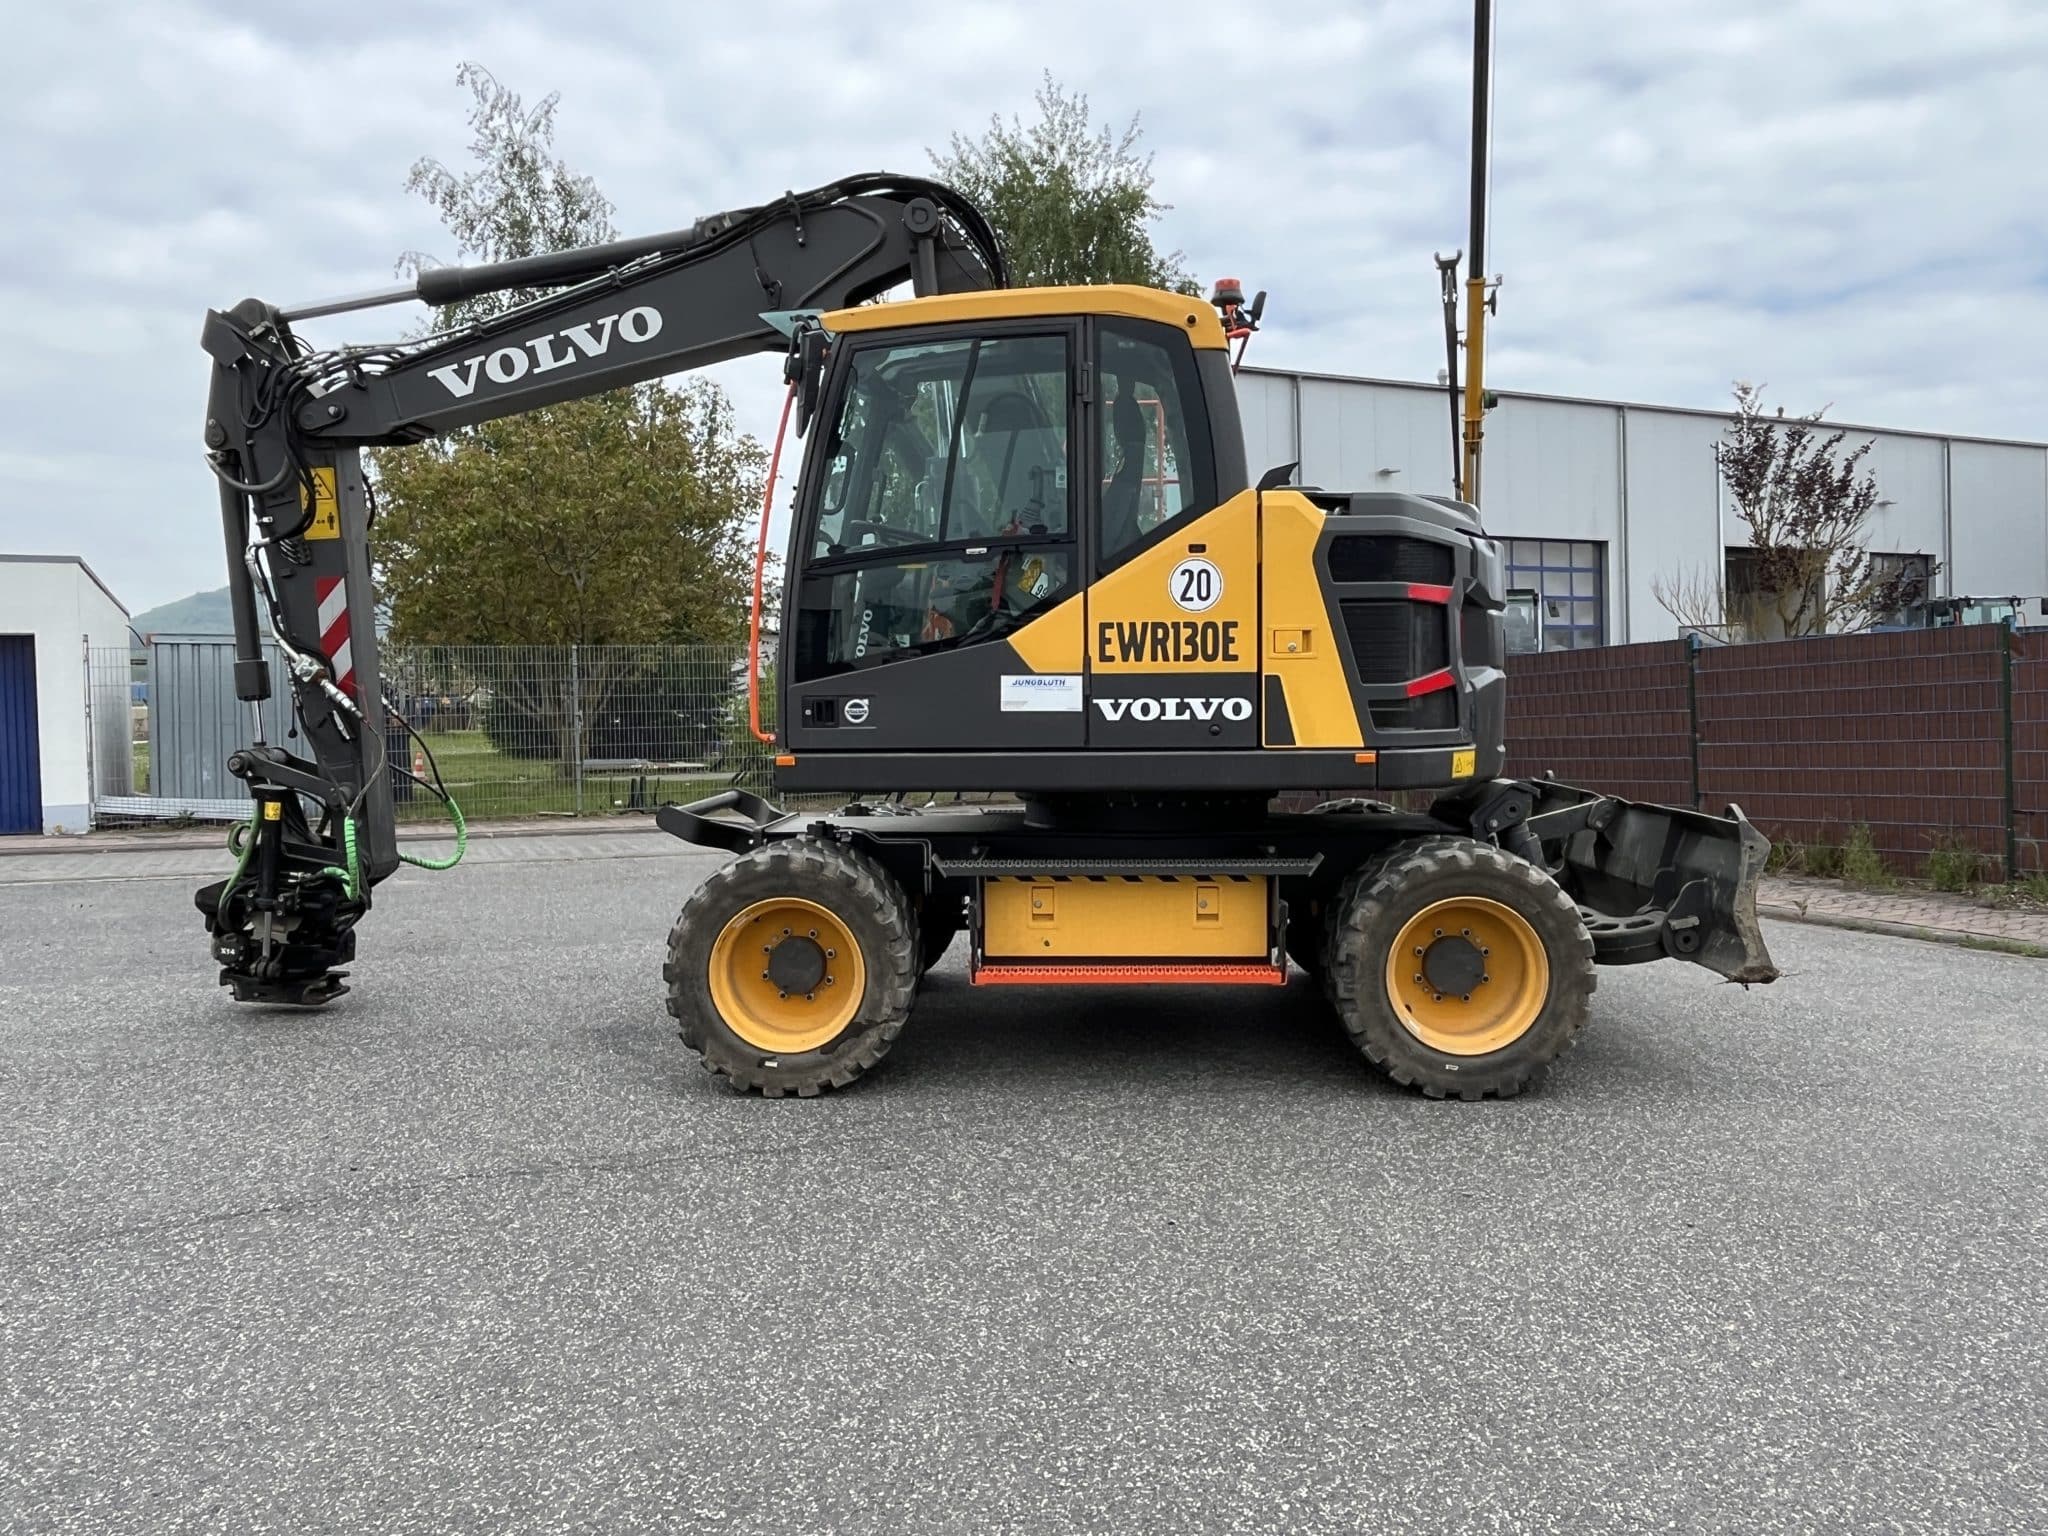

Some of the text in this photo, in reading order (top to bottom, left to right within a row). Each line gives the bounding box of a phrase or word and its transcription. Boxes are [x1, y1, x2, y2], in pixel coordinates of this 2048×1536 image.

[426, 306, 663, 398] VOLVO
[1180, 568, 1211, 602] 20
[855, 609, 873, 659] OLVO
[1098, 621, 1239, 663] EWR130E
[1092, 697, 1253, 721] VOLVO
